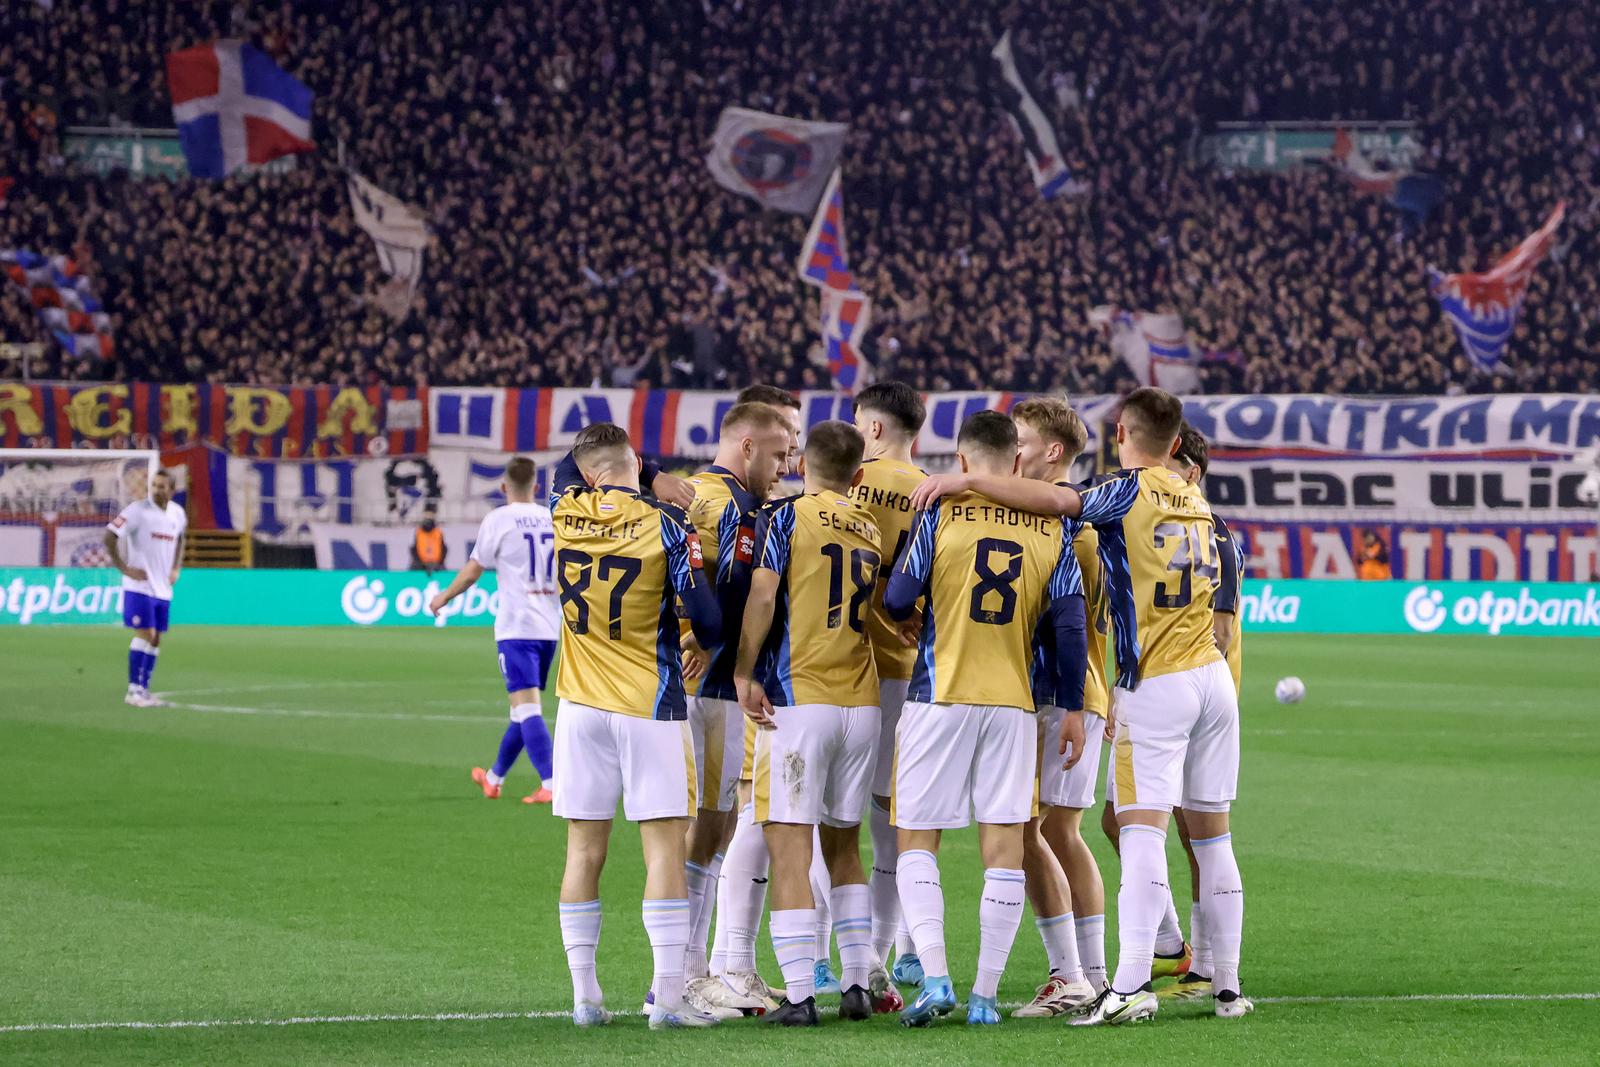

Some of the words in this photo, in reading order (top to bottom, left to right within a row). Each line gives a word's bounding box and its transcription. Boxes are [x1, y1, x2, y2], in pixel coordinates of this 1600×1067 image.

[523, 532, 556, 583] 17
[557, 547, 642, 641] 87
[820, 542, 881, 634] 18
[969, 537, 1024, 626] 8
[1153, 522, 1220, 608] 34
